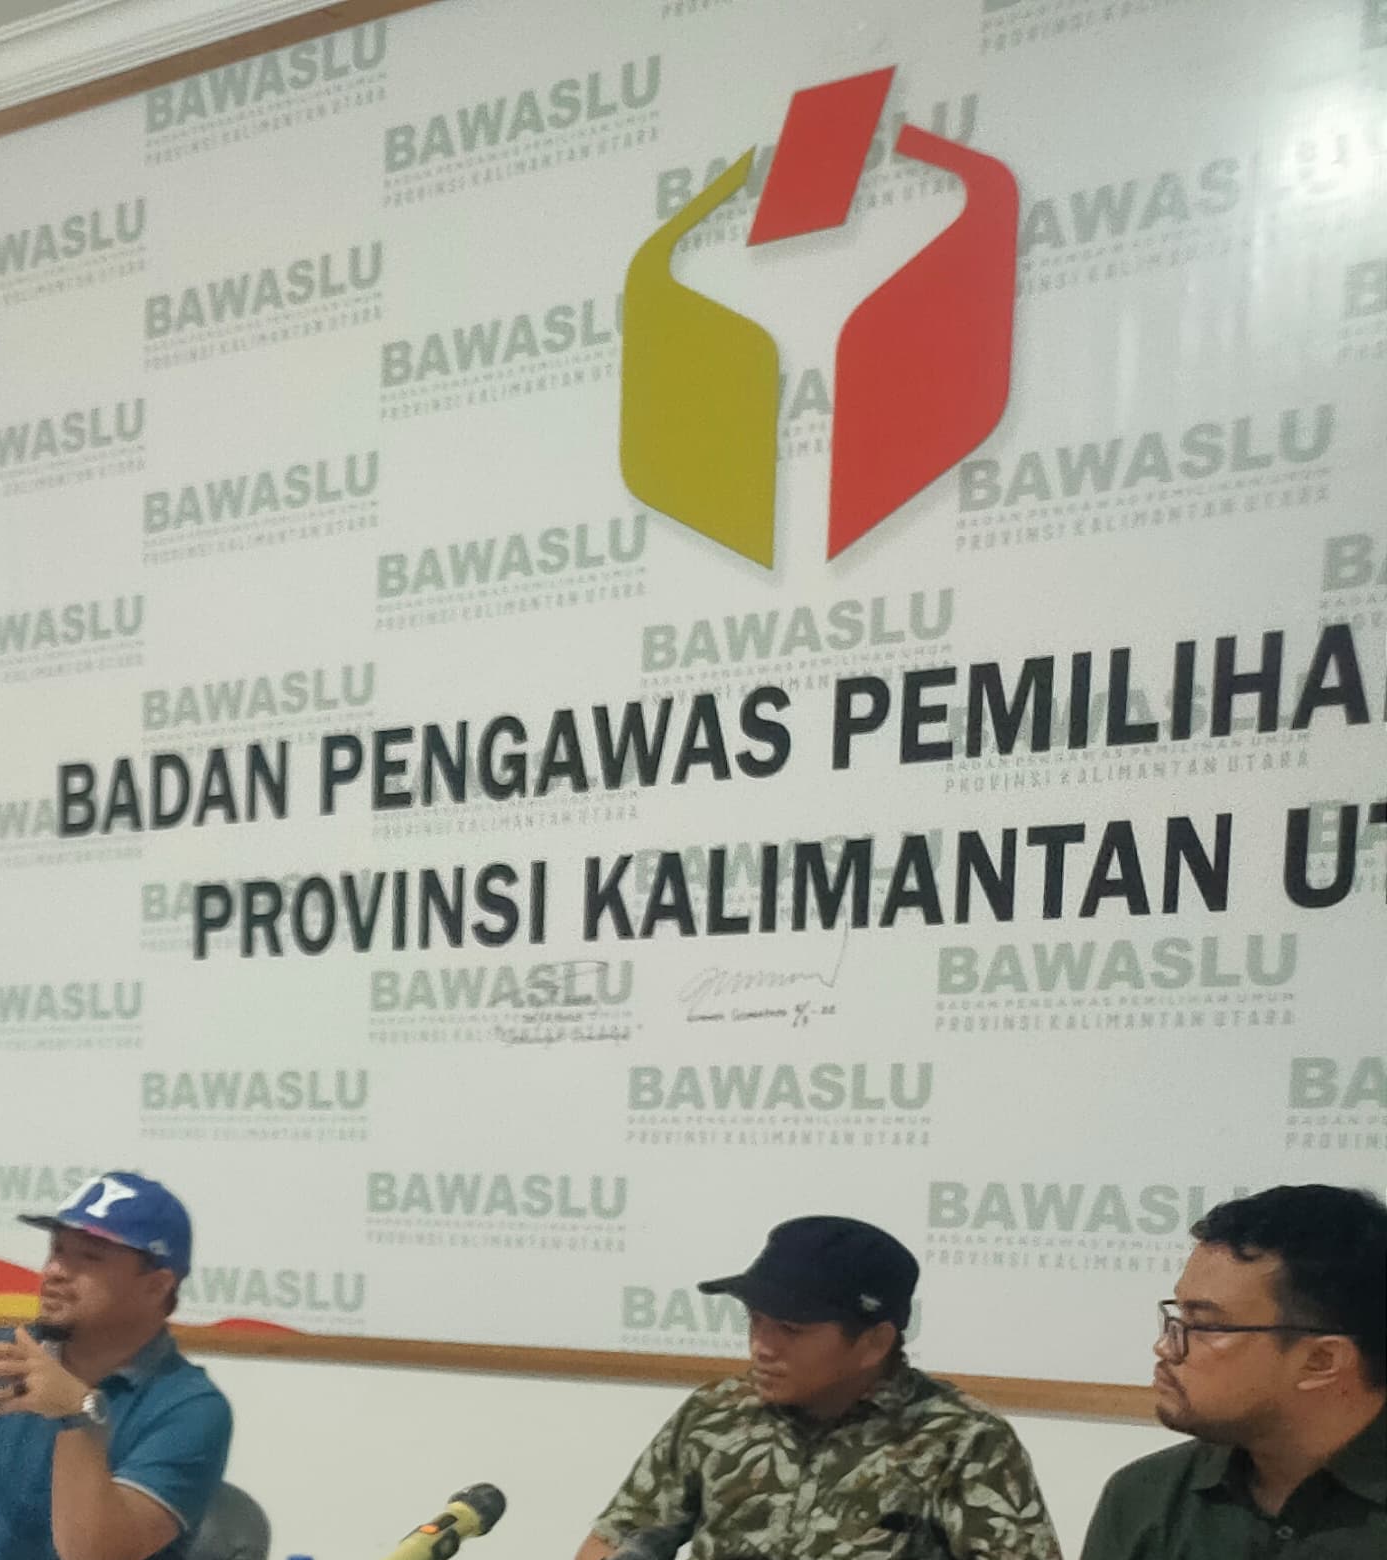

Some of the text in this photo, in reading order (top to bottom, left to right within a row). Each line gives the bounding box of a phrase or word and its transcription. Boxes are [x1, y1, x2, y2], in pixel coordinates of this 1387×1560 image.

[384, 54, 661, 174] BAWASLU
[143, 242, 383, 340] BAWASLU
[380, 293, 624, 388] BAWASL
[142, 451, 380, 535] BAWASLU
[959, 403, 1335, 513] BAWASLU
[377, 513, 647, 598] BAWASLU
[641, 588, 954, 673] BAWASLU
[56, 624, 1387, 839] BADAN PENGAWAS PEMILIHA
[141, 661, 376, 731] BAWASLU
[192, 860, 547, 961] PROVINSI
[583, 813, 1233, 942] KALIMANTAN
[937, 933, 1298, 994] BAWASLU
[141, 1069, 369, 1112] BAWASLU
[628, 1062, 933, 1111] BAWASLU
[366, 1171, 627, 1219] BAWASLU
